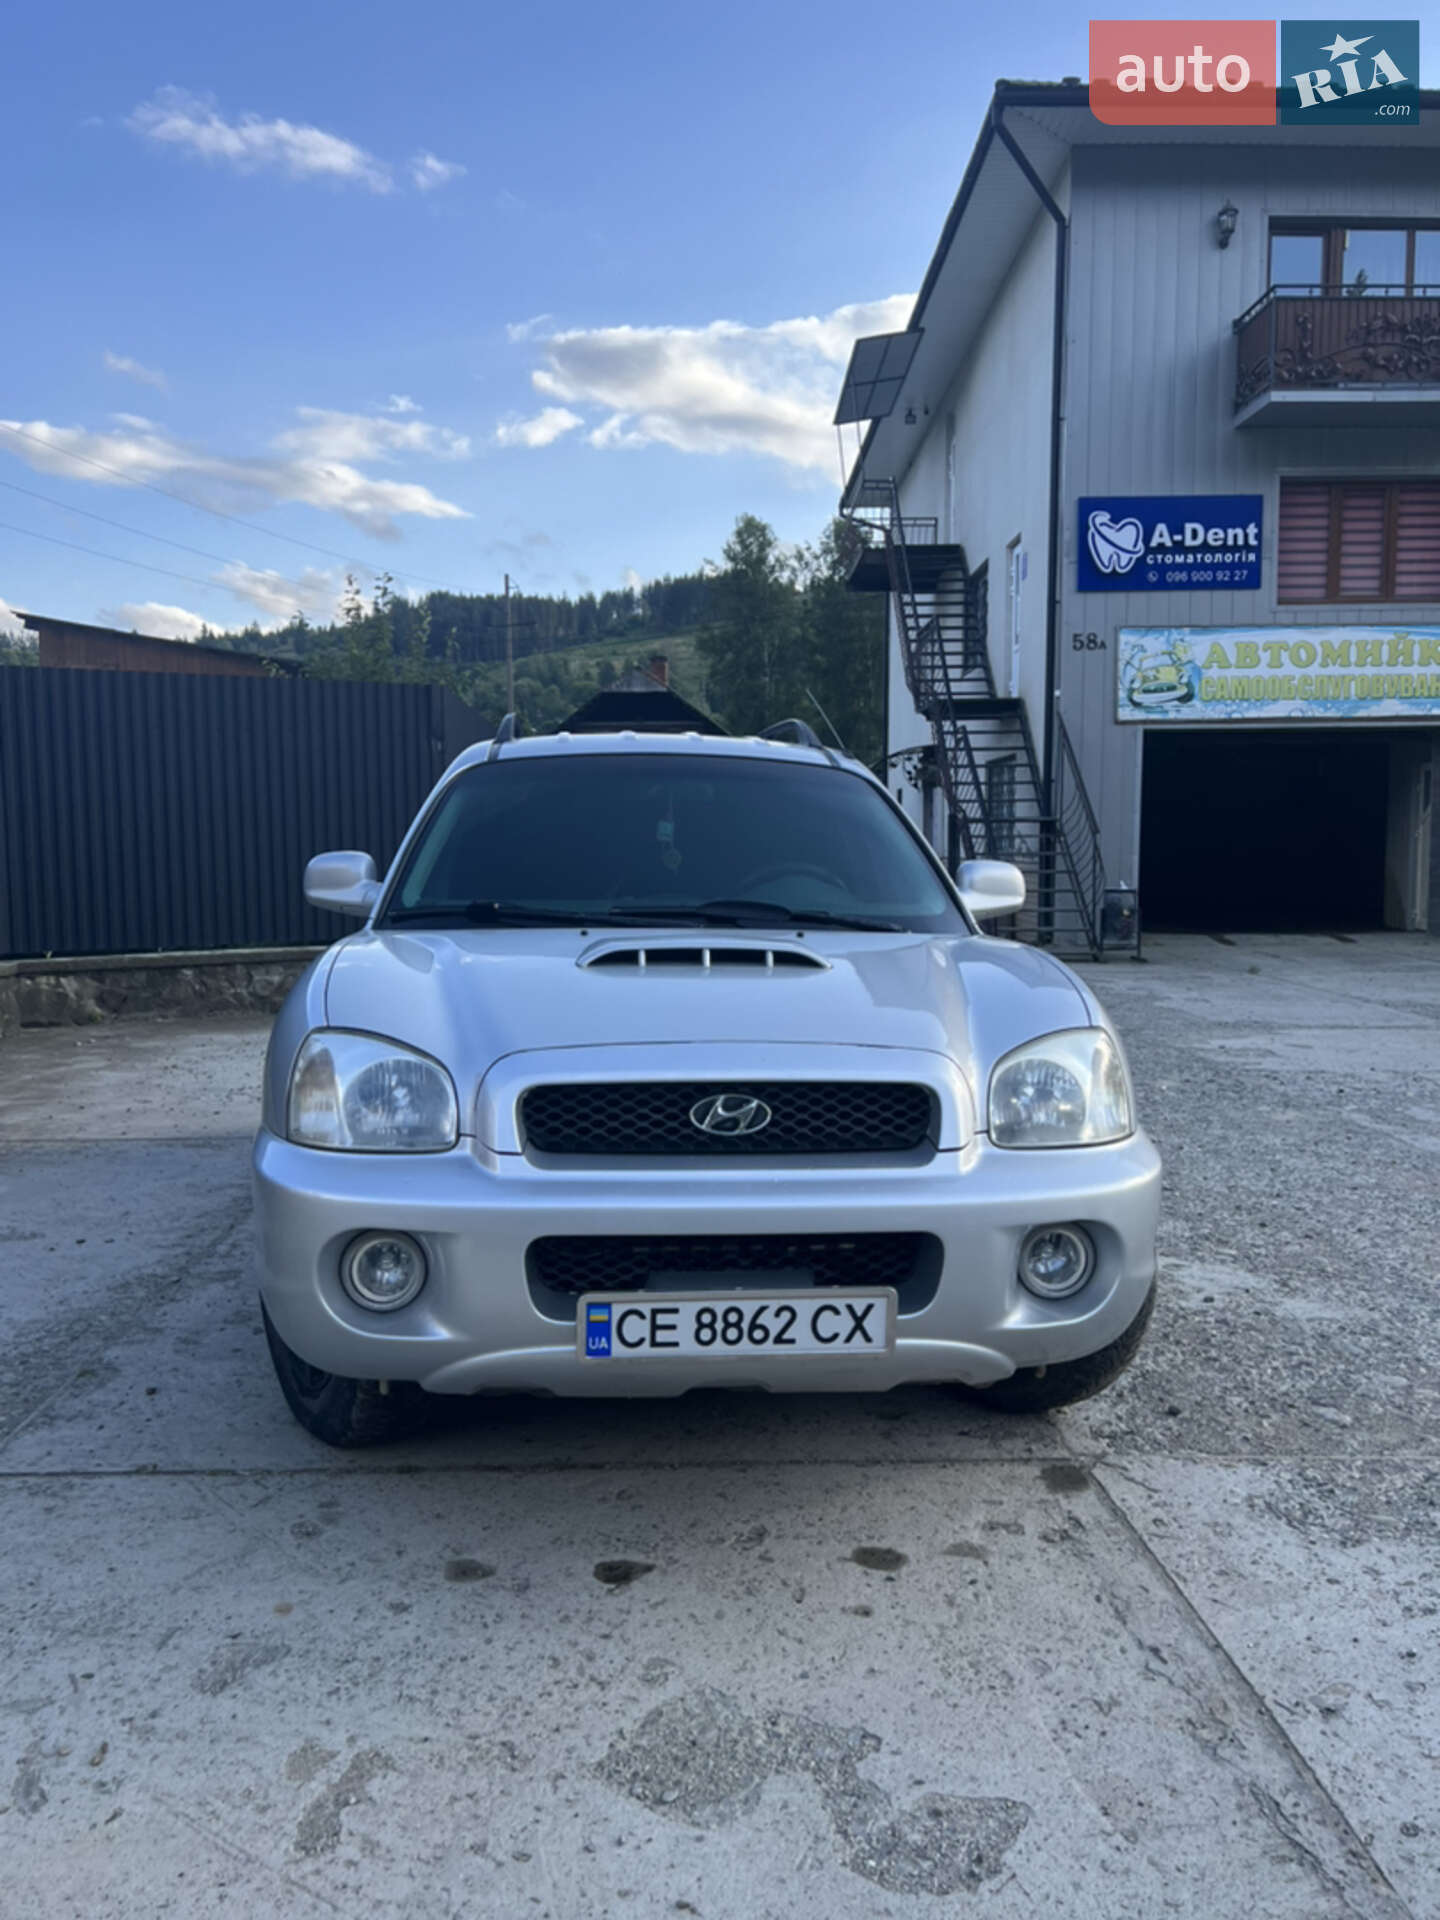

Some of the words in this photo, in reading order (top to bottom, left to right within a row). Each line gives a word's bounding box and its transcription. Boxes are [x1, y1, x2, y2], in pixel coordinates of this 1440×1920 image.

[1149, 522, 1259, 547] A-Dent
[1146, 550, 1256, 564] стоматологія
[1165, 571, 1189, 582] 096
[1233, 569, 1249, 581] 27
[1202, 632, 1440, 668] АВТОМИЙК
[616, 1307, 680, 1348] CE
[694, 1305, 797, 1346] 8862
[810, 1303, 875, 1344] CX
[588, 1337, 609, 1350] UA
